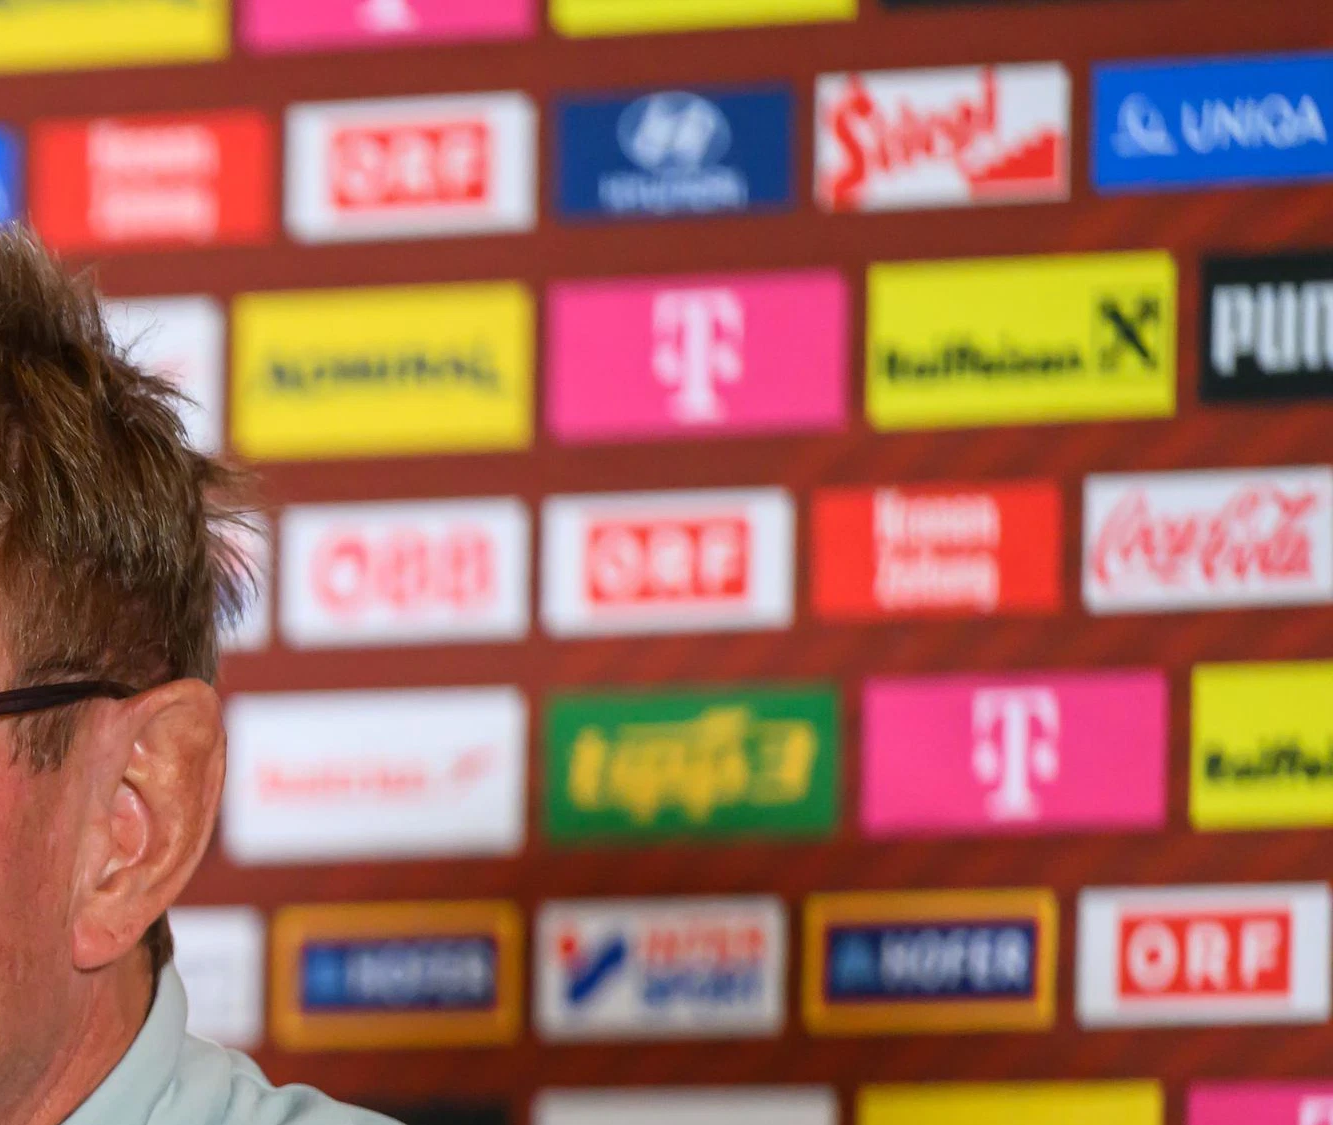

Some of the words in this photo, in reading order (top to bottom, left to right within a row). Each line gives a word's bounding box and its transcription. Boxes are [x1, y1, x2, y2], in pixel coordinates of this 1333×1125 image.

[1181, 93, 1327, 154] UNIQA
[653, 288, 742, 424] T
[972, 685, 1059, 822] T
[1126, 916, 1285, 994] ORF
